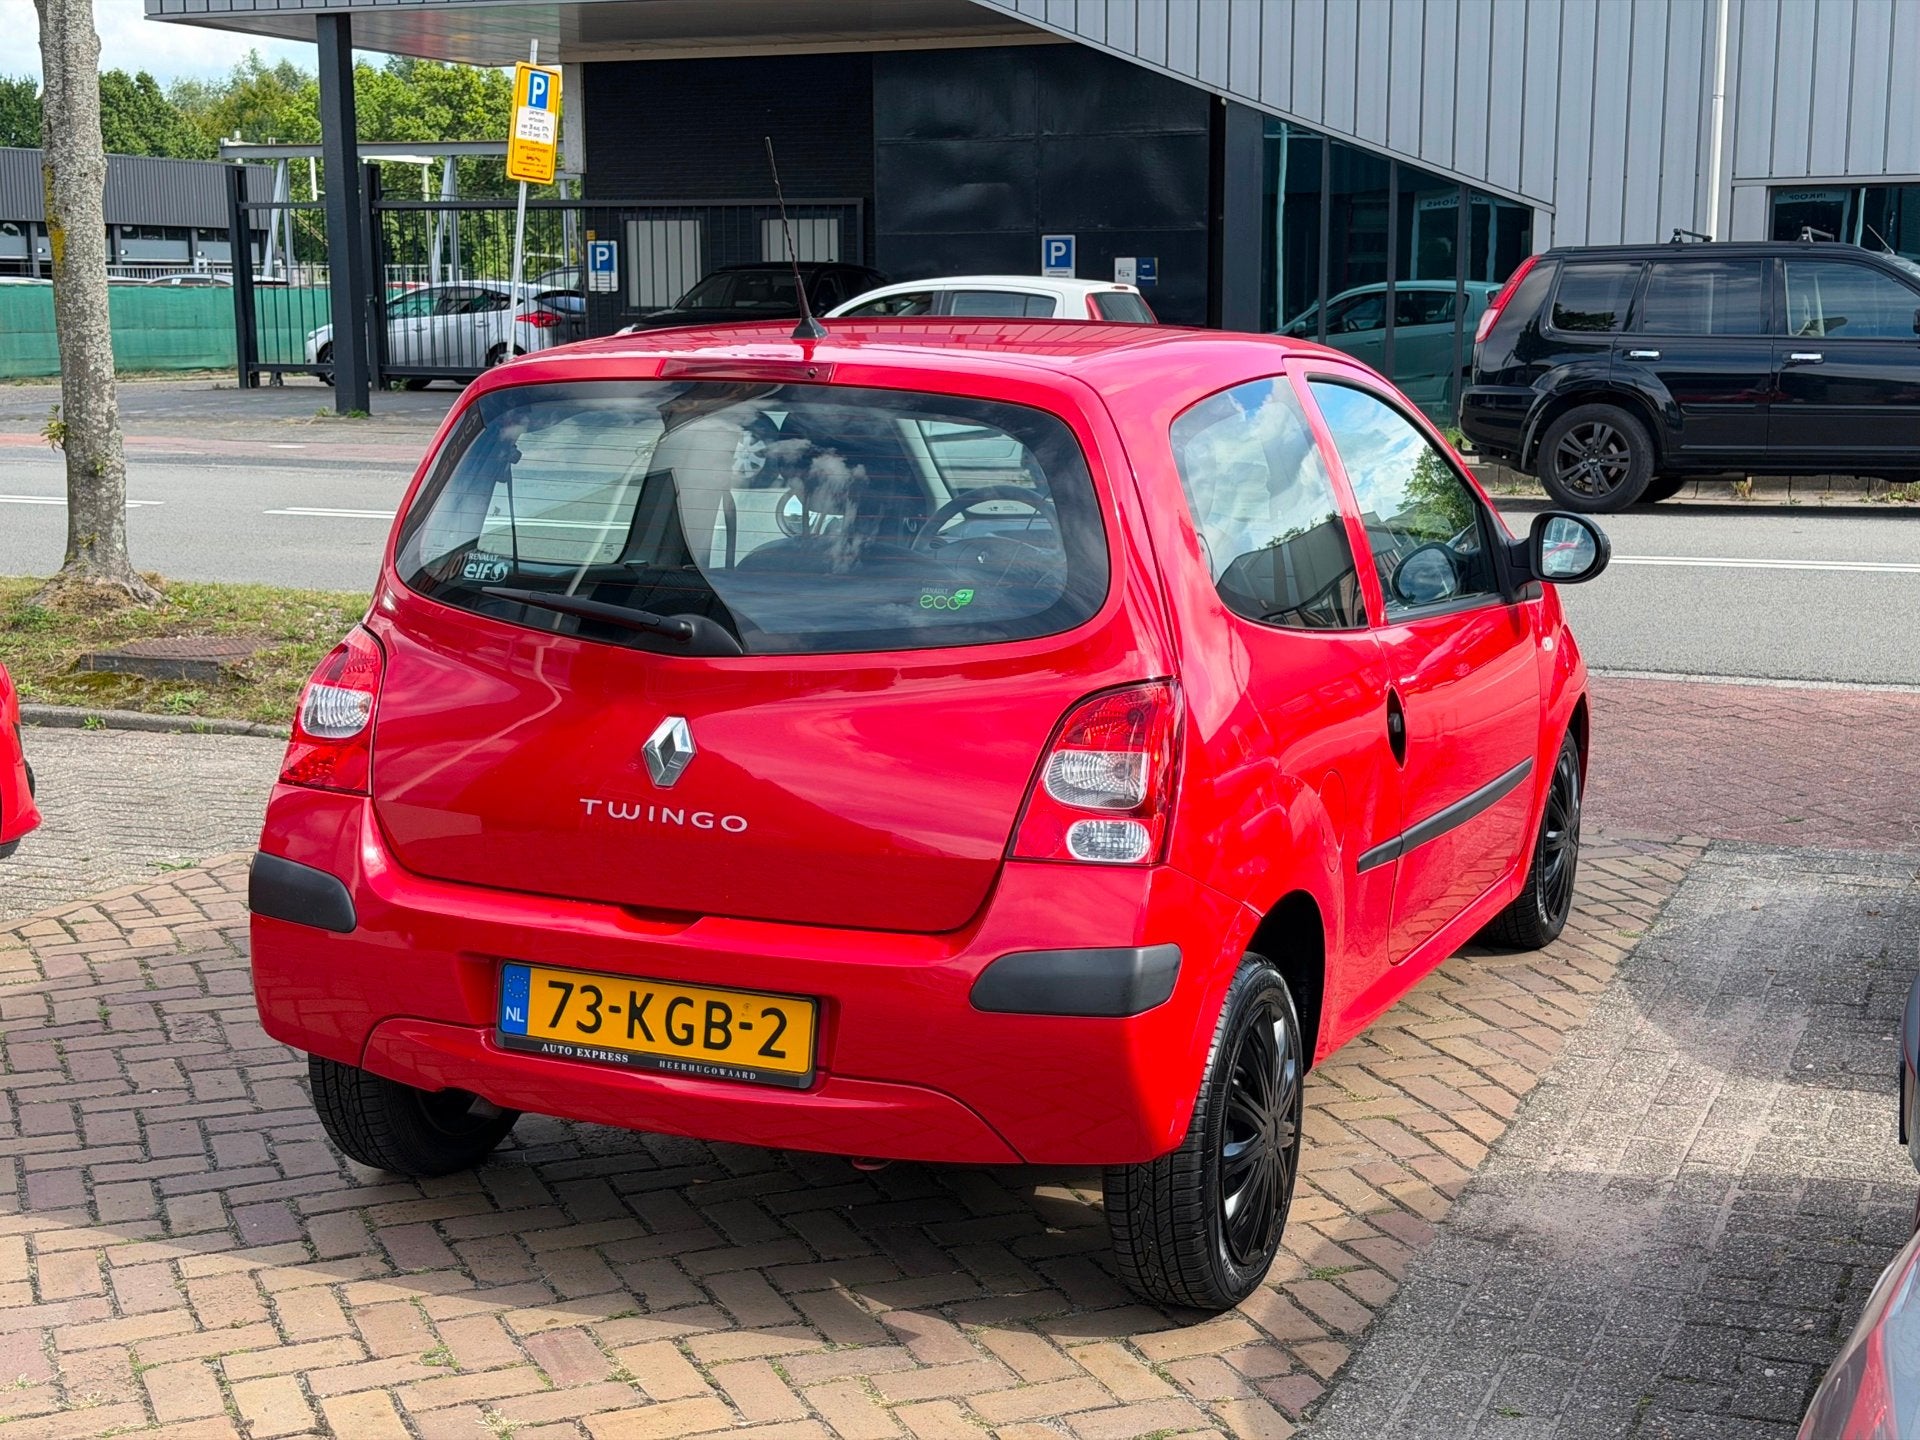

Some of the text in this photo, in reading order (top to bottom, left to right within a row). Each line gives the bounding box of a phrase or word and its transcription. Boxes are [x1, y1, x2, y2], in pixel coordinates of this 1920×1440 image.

[531, 76, 546, 105] P
[596, 247, 610, 269] P
[1050, 241, 1067, 266] P
[468, 552, 499, 562] RENAULT
[463, 562, 493, 579] elf
[920, 594, 961, 611] eco
[579, 798, 748, 833] TWINGO
[505, 1005, 525, 1023] NL
[547, 980, 788, 1059] 73-KGB-2
[541, 1043, 630, 1064] AUTO EXPRESS
[659, 1060, 757, 1081] HEERHUGOWAARD
